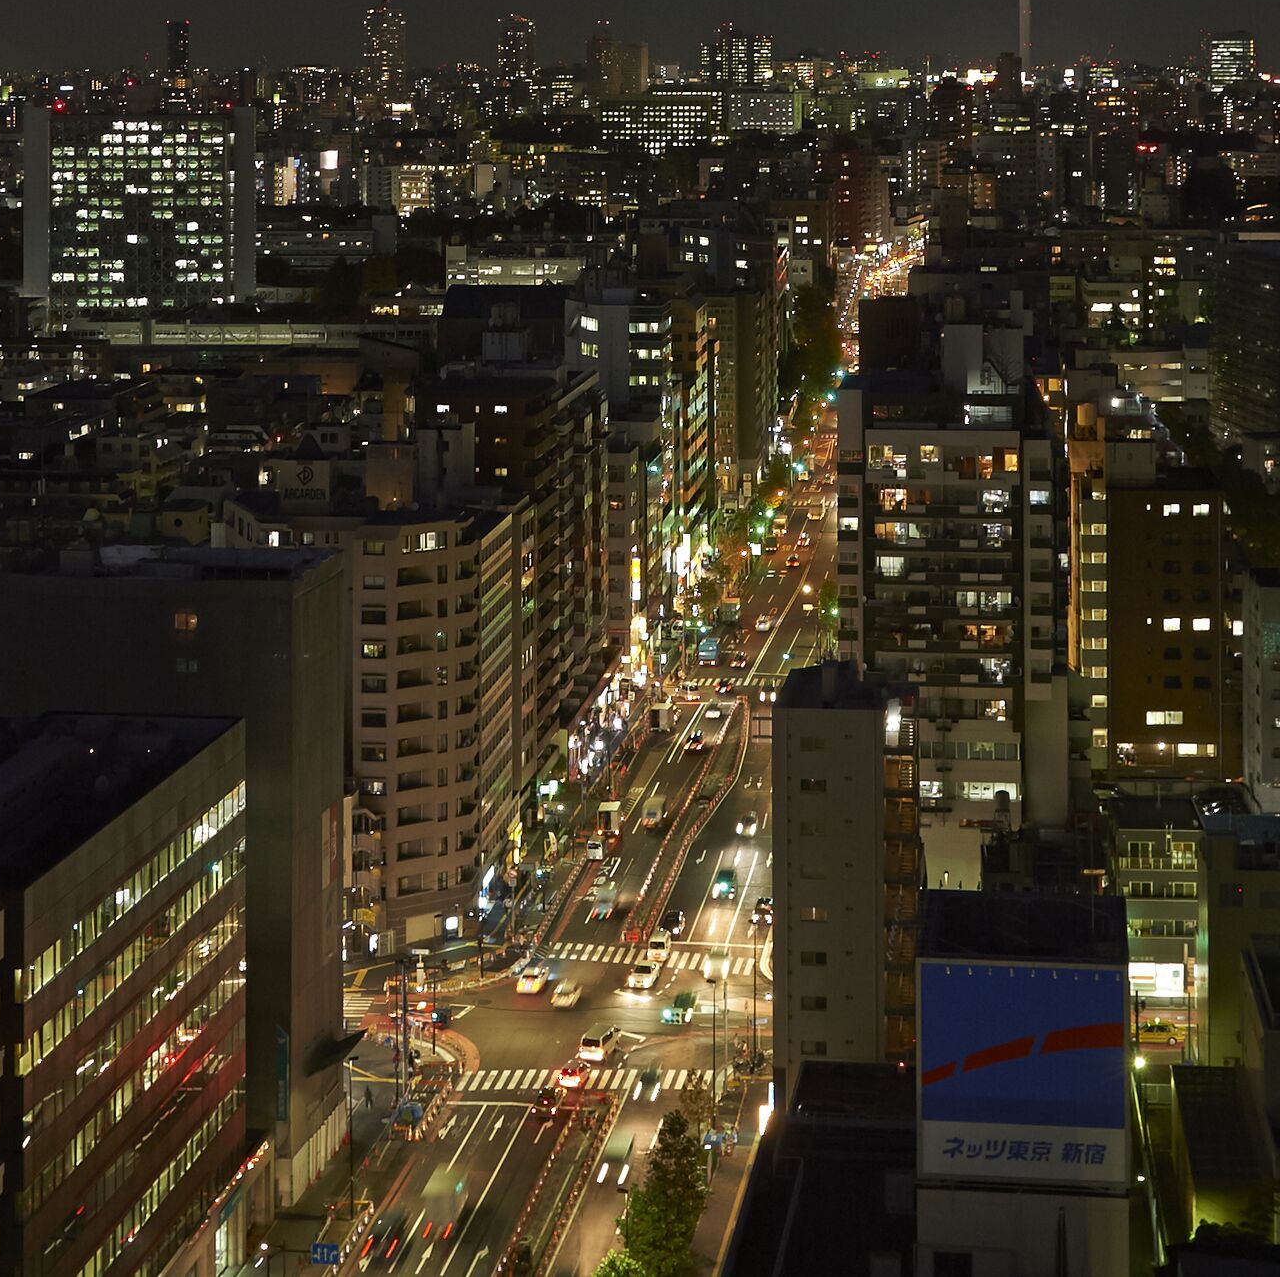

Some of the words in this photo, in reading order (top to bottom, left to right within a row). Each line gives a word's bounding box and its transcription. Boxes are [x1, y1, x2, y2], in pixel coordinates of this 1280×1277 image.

[943, 1137, 1053, 1162] ネッツ東京
[1061, 1142, 1107, 1165] 新宿
